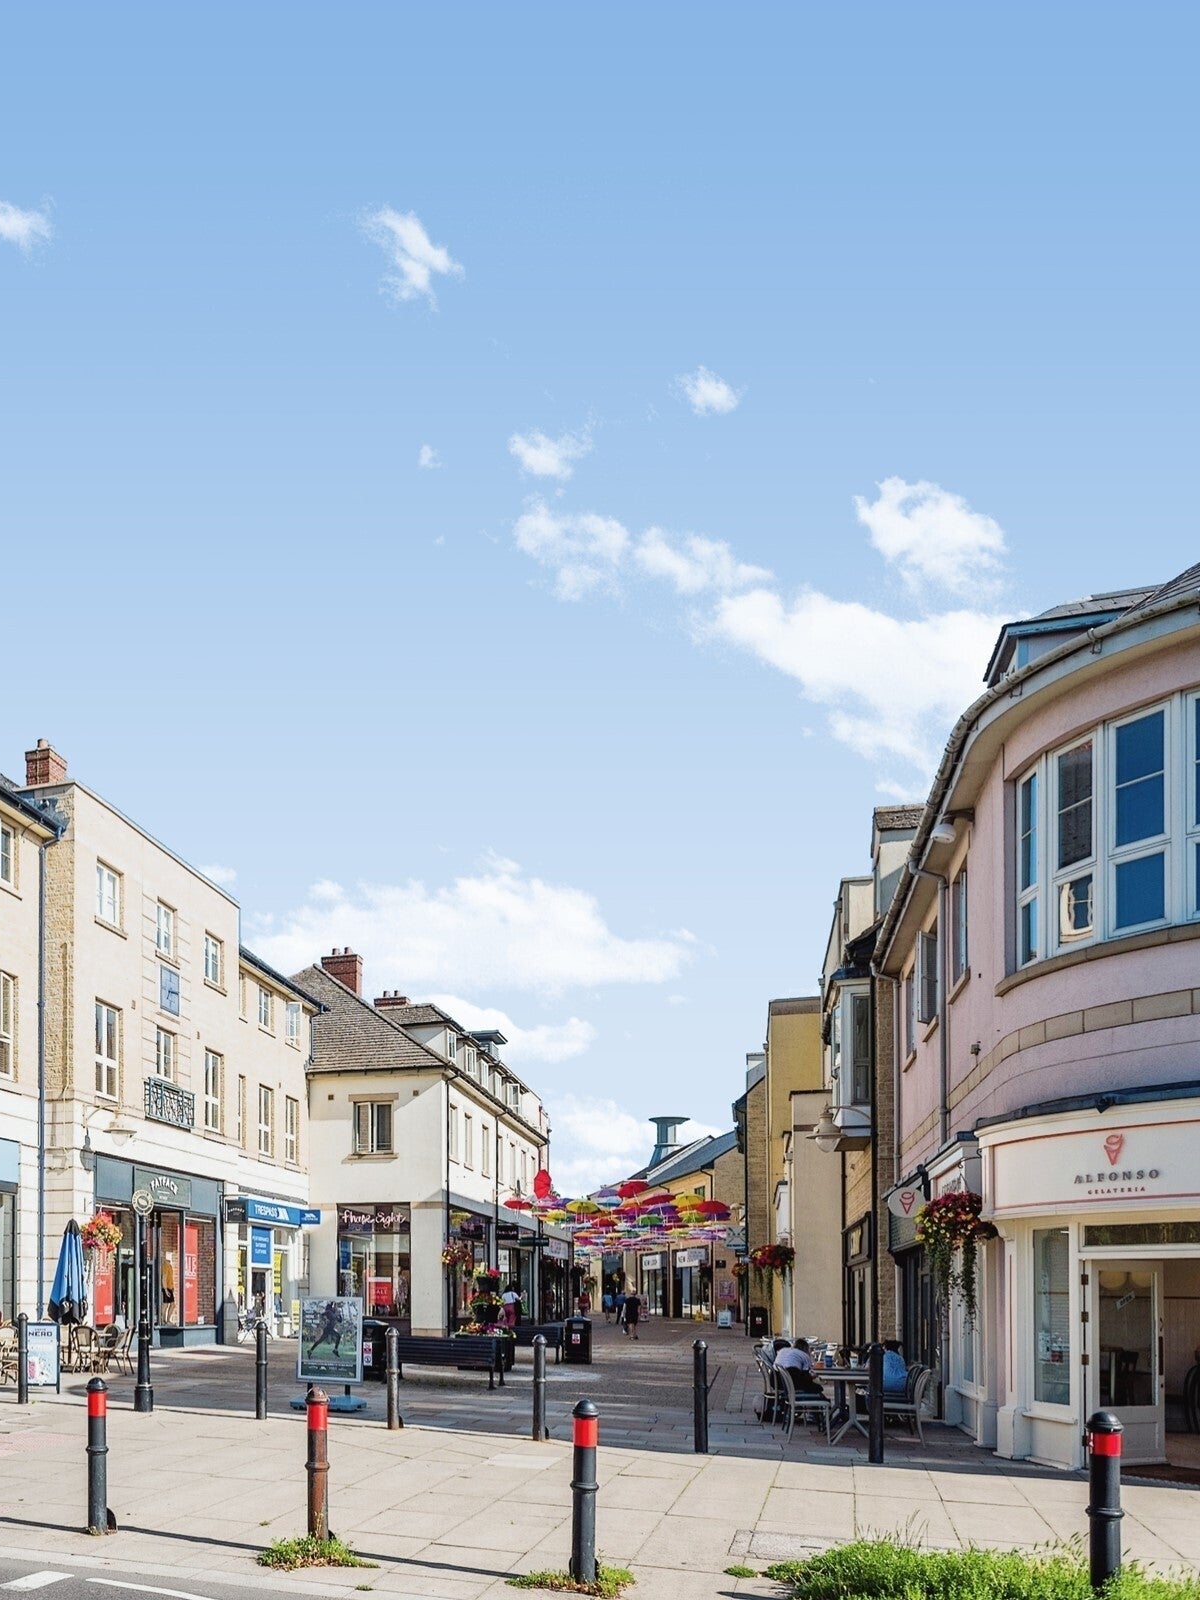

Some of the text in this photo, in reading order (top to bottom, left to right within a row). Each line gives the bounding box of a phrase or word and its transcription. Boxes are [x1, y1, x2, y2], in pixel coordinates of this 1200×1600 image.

[1073, 1169, 1160, 1185] ALFONSO
[1087, 1186, 1146, 1195] GELATERIA
[254, 1204, 278, 1217] TRESPASS
[375, 1211, 407, 1229] Eight
